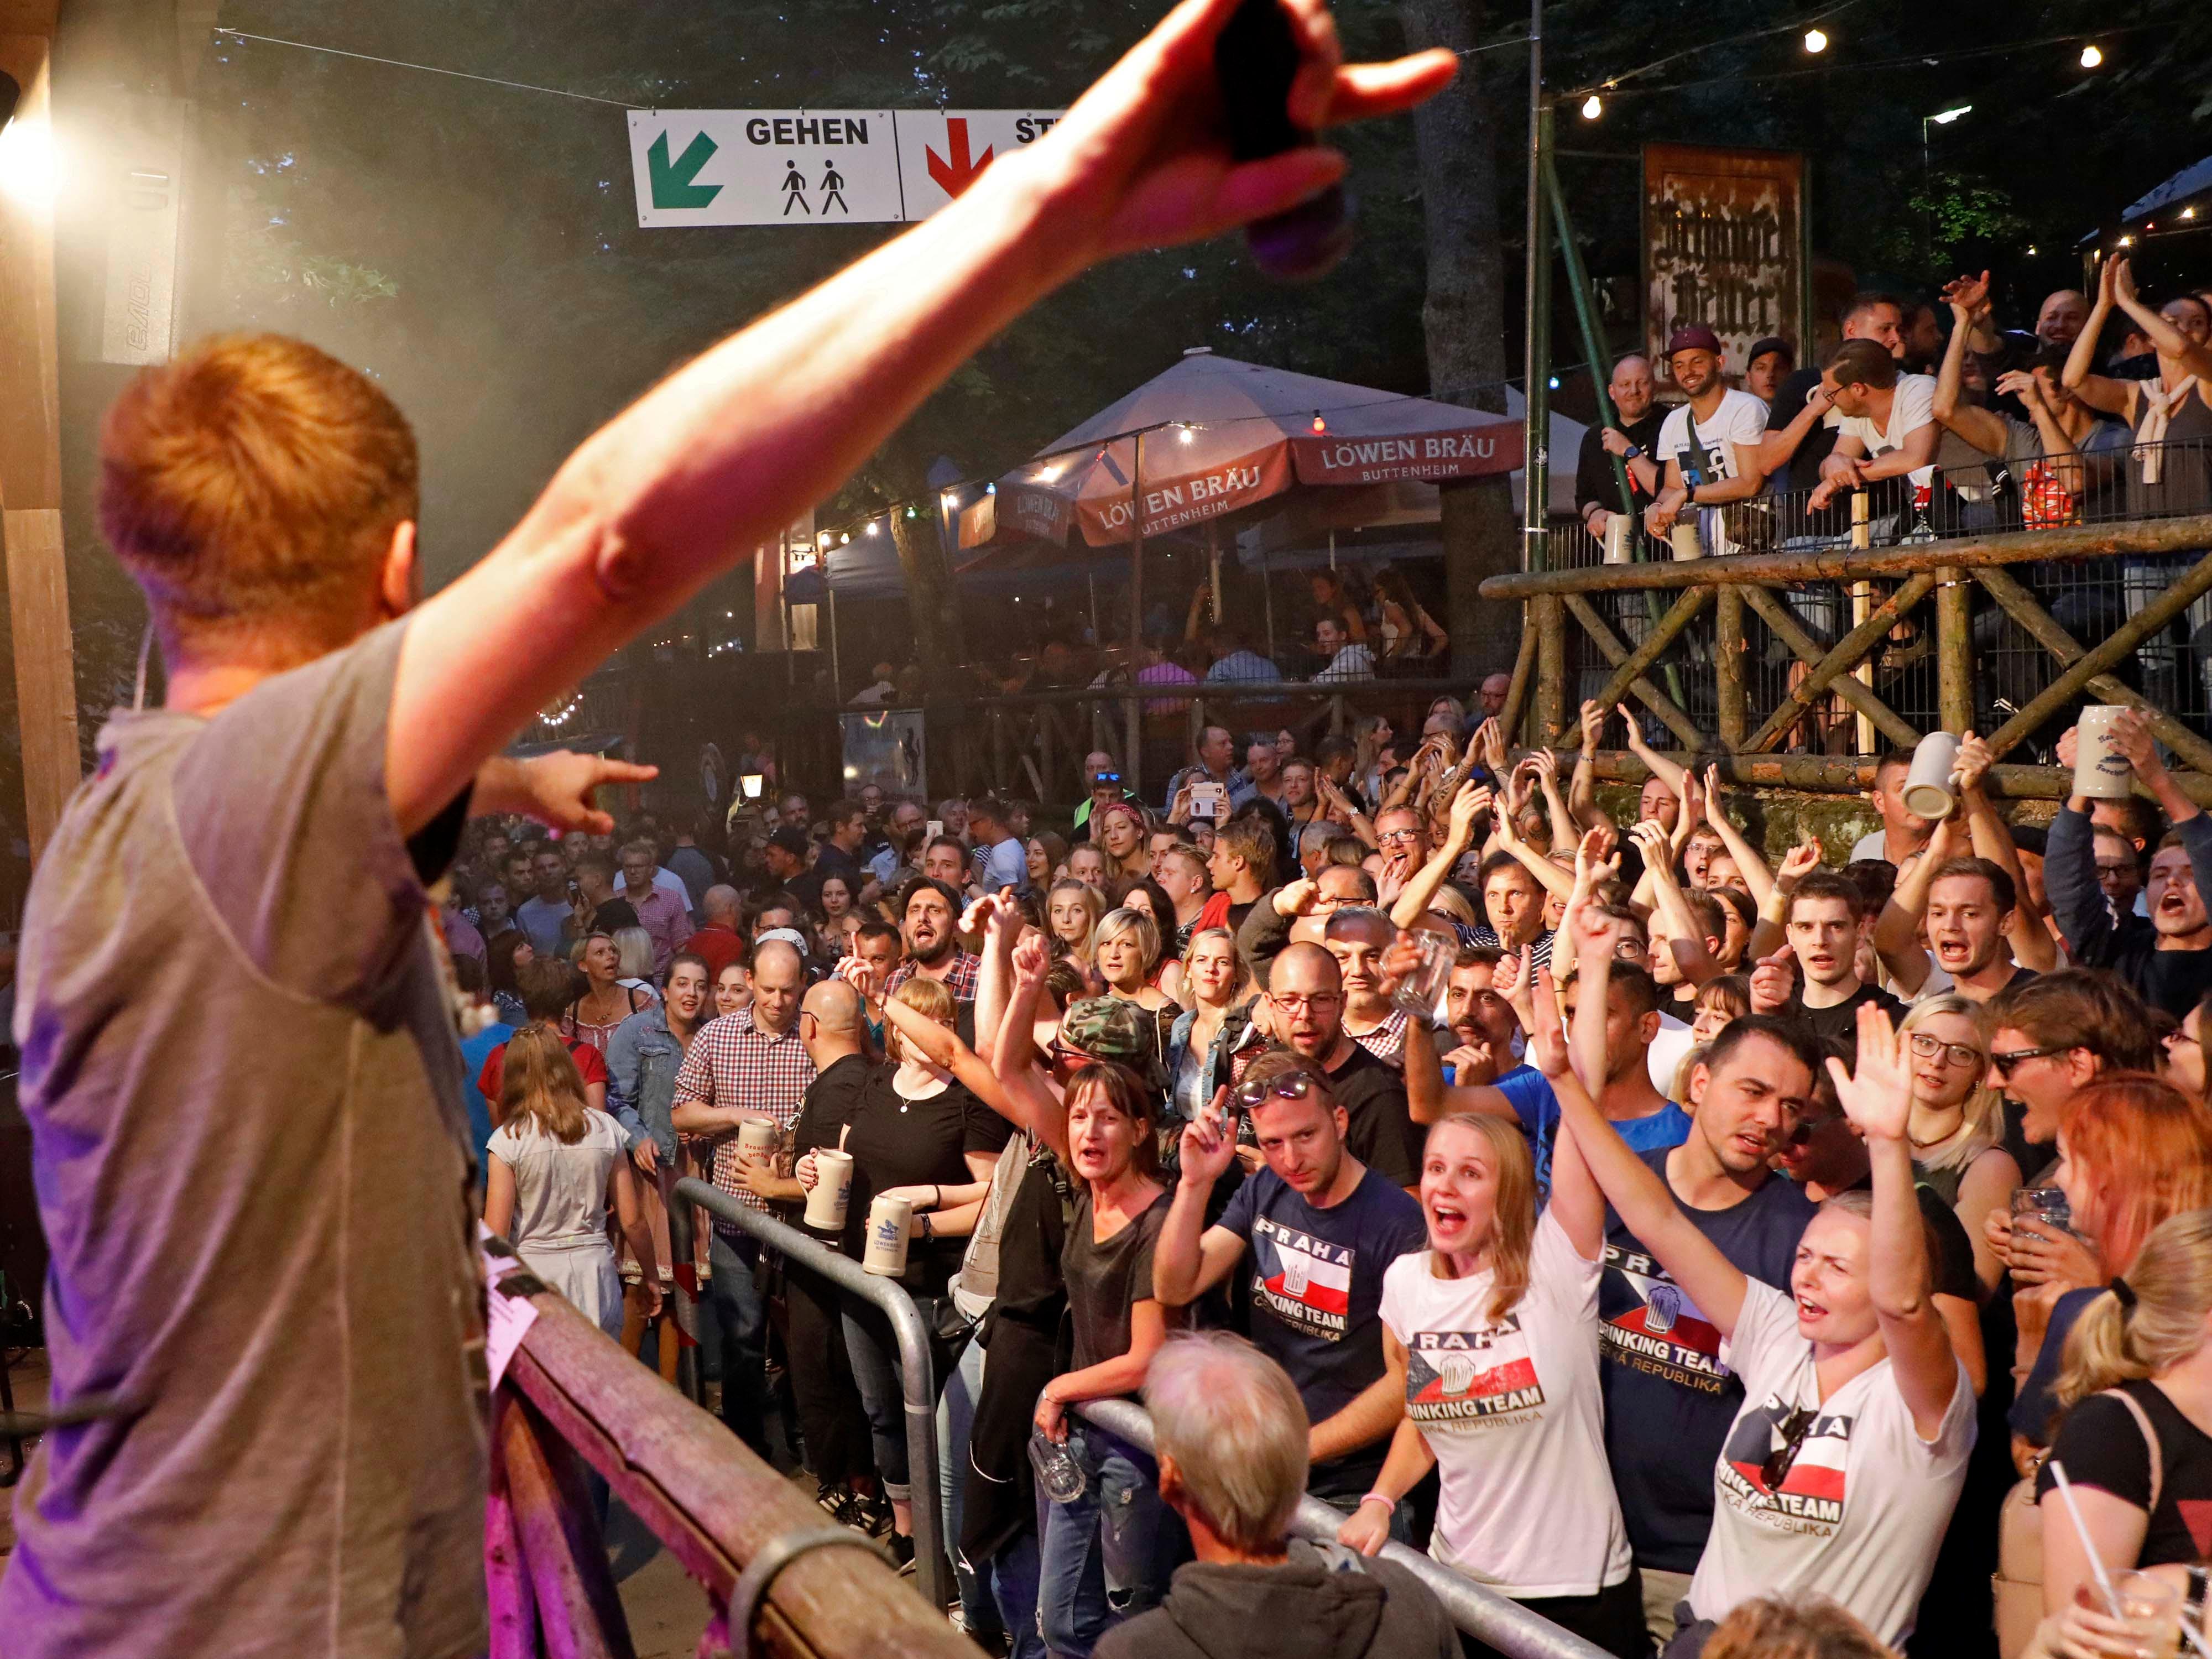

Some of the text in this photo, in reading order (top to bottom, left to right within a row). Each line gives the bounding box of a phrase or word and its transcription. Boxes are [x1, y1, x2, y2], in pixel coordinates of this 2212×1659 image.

[746, 118, 868, 145] GEHEN
[1321, 435, 1495, 469] LÖWEN BRÄU
[1190, 466, 1260, 500] BRÄU
[1362, 464, 1459, 481] BUTTENHEIM
[1141, 500, 1228, 535] UTTENHEIM
[1255, 1218, 1349, 1266] PRAHA
[1305, 1306, 1345, 1331] TEAM
[1420, 1319, 1517, 1349] RAHA
[1632, 1358, 1721, 1394] REPUBLIKA
[1674, 1347, 1729, 1376] TEAM
[1408, 1386, 1542, 1420] RINKING TEAM
[1451, 1411, 1543, 1432] REPUBLIKA
[1746, 1507, 1832, 1536] REPUBLIKA
[1777, 1494, 1840, 1521] TEAM
